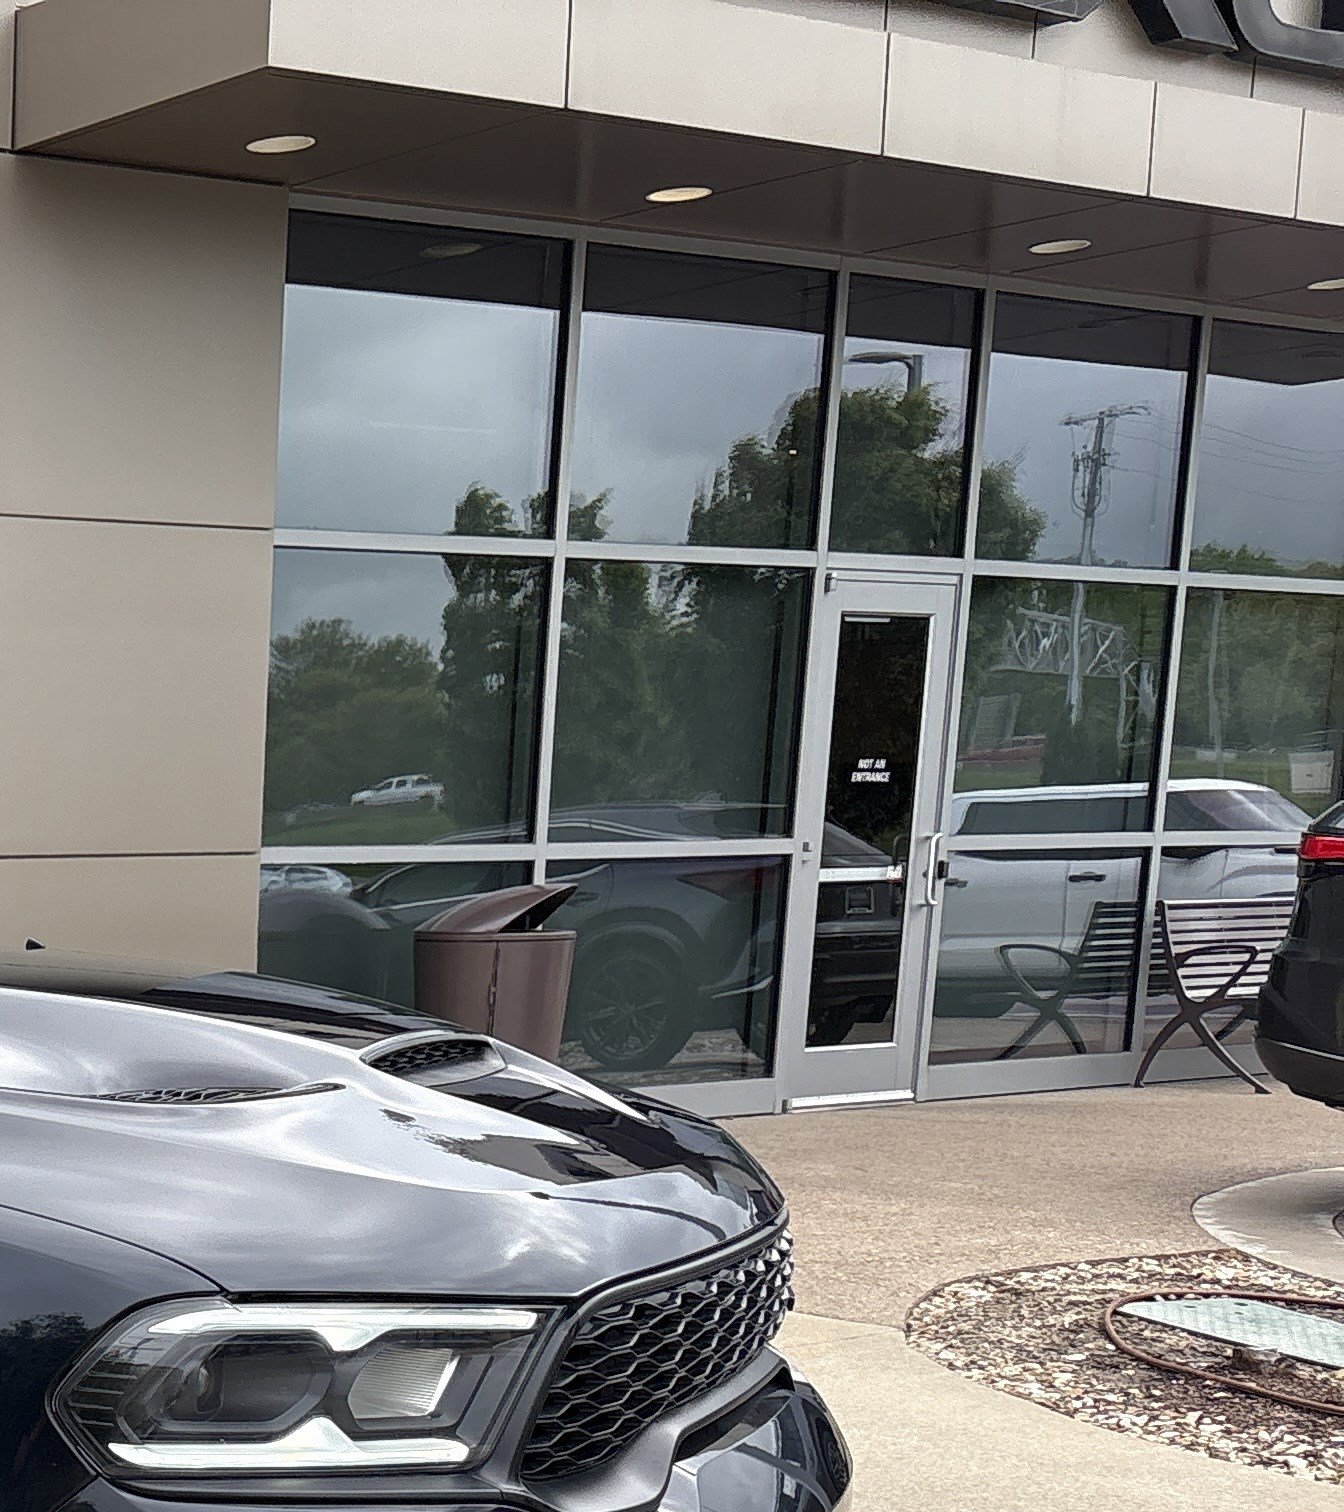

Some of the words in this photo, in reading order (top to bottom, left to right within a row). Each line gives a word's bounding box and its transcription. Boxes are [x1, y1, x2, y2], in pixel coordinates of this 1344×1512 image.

[857, 758, 874, 769] NOT
[874, 758, 887, 769] AN
[851, 771, 891, 783] ENTRANCE
